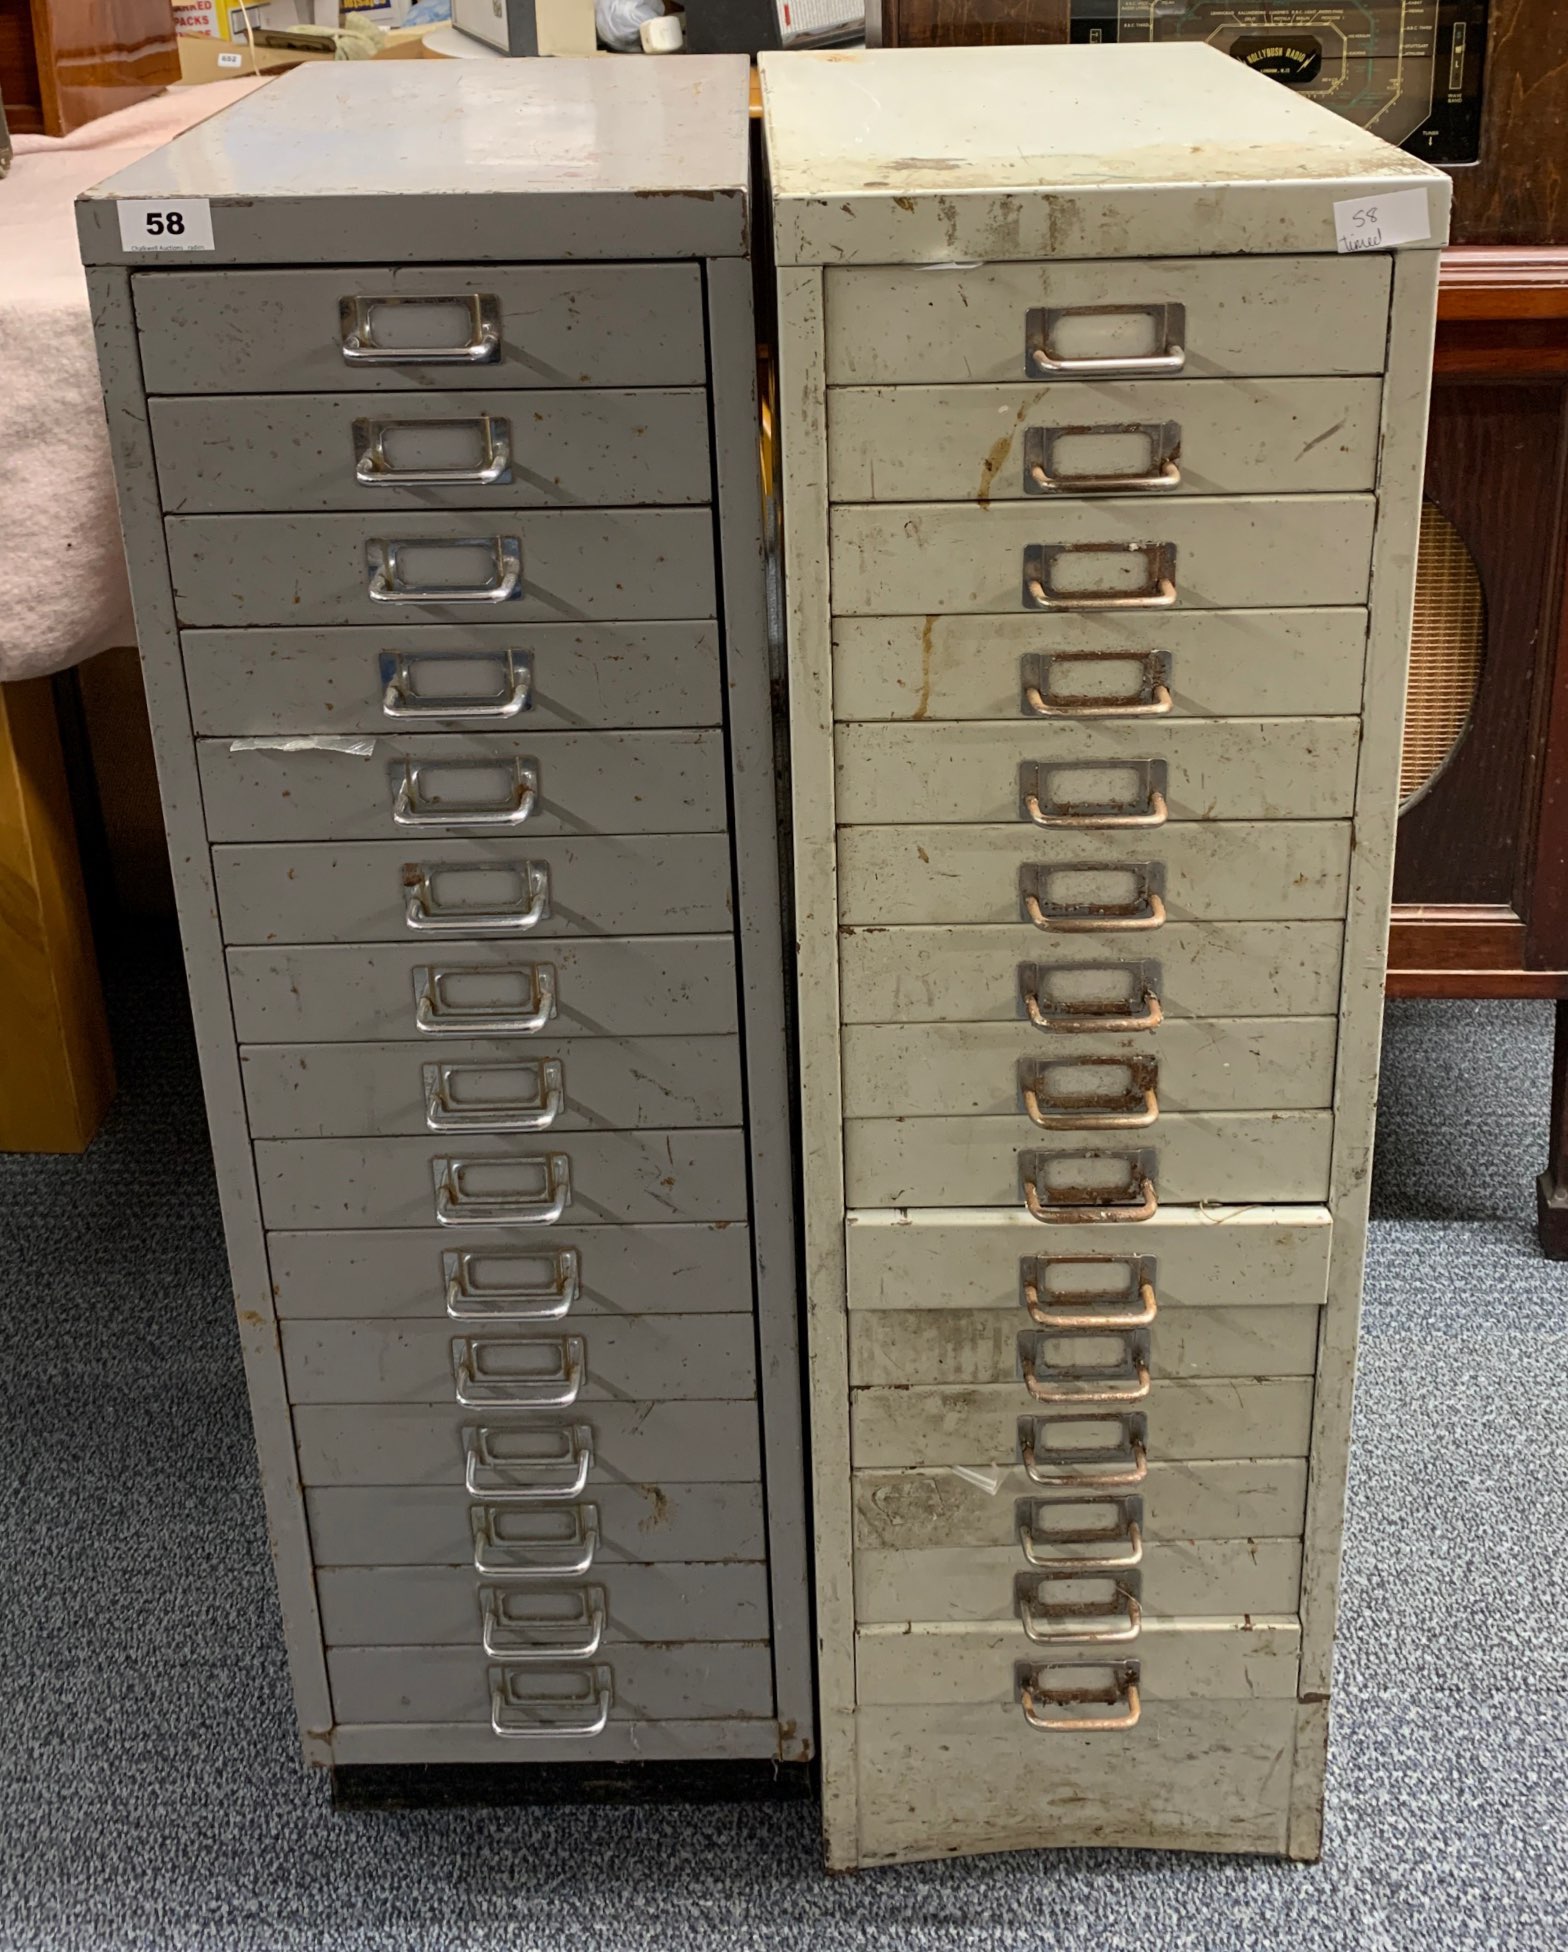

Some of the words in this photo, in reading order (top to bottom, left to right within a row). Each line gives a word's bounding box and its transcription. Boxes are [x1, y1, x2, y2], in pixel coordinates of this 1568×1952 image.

[175, 15, 209, 26] PACKS
[1246, 47, 1283, 63] HOLLYBUSH
[1285, 47, 1307, 63] RADIO
[146, 212, 185, 235] 58
[1352, 207, 1378, 228] 58
